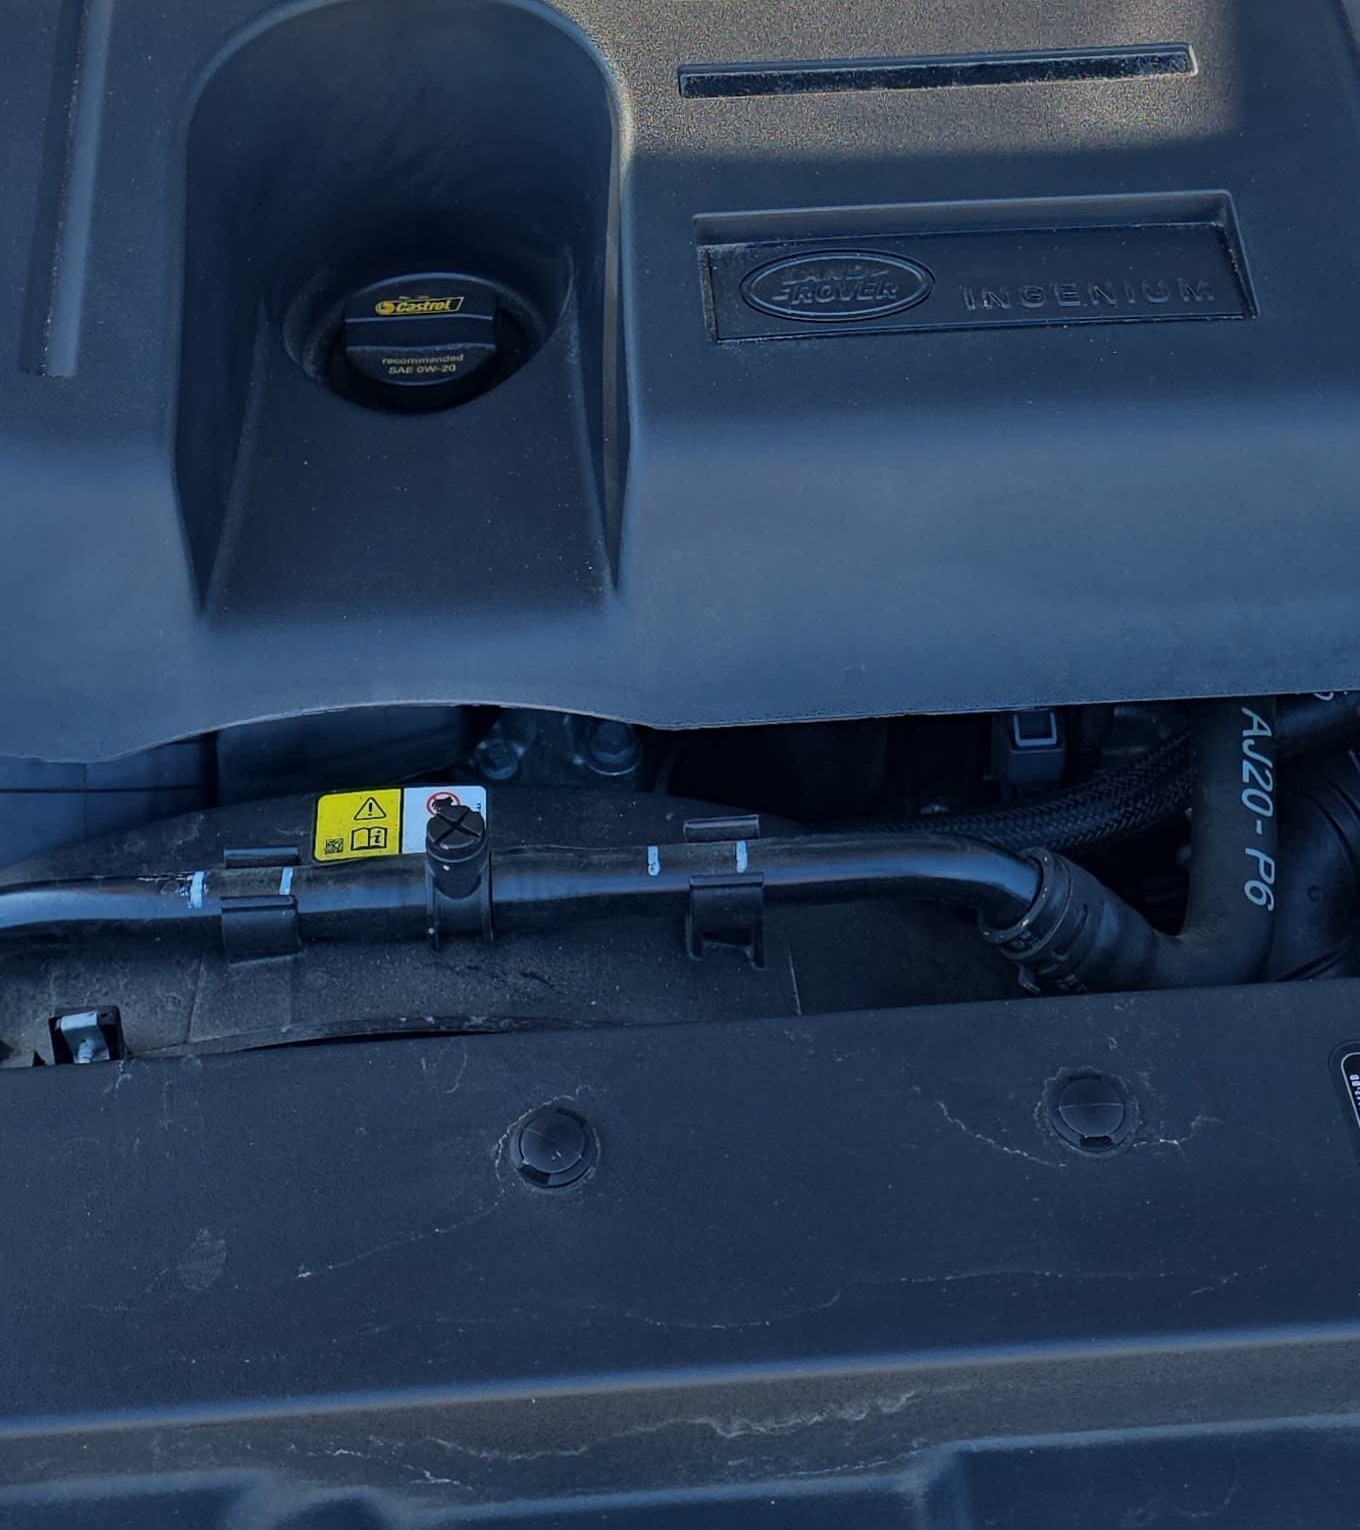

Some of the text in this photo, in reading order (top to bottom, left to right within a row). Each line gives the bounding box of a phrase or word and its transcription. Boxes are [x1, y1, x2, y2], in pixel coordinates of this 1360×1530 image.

[783, 267, 878, 286] LAND
[787, 279, 900, 306] ROVER
[962, 276, 1217, 311] INGENIUM
[396, 299, 452, 314] Castrol
[382, 353, 464, 365] recommended
[388, 365, 413, 374] SAE
[1244, 846, 1276, 911] P6
